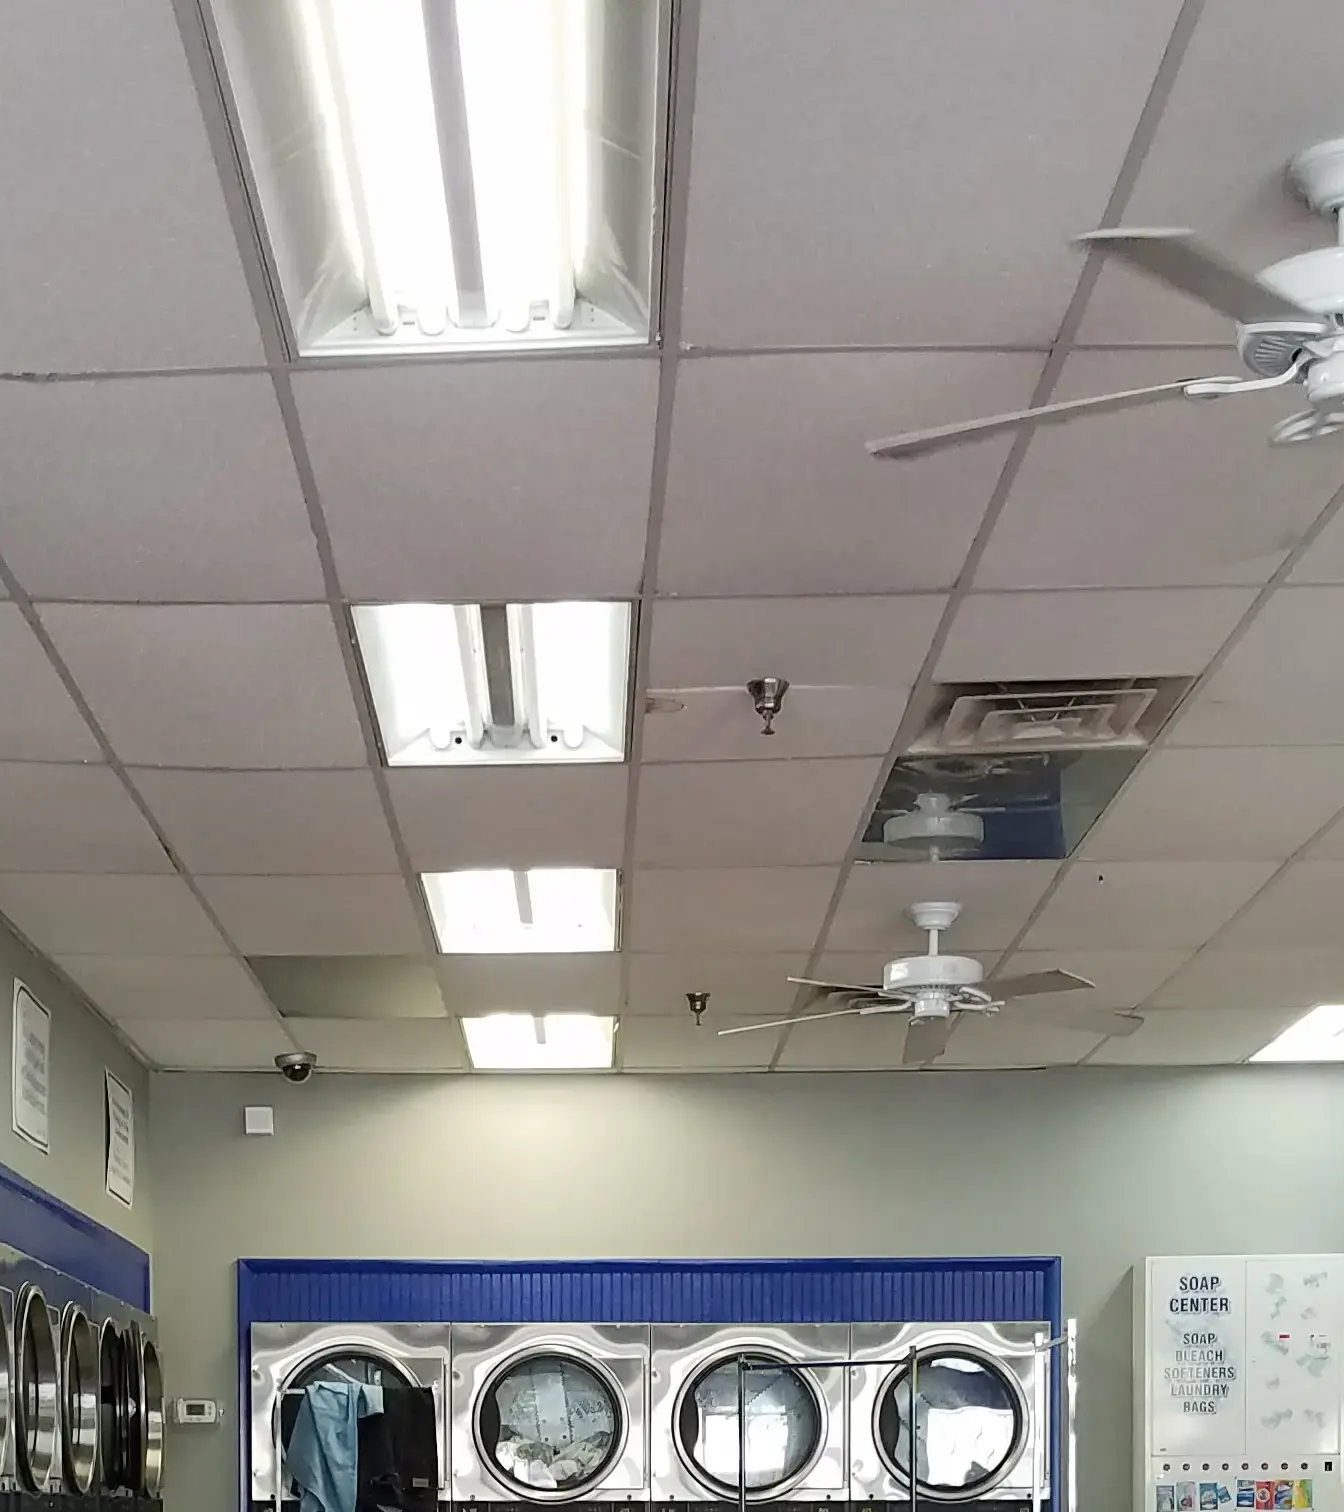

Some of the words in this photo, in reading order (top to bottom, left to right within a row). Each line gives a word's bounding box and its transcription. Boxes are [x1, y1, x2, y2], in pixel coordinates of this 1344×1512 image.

[1179, 1276, 1220, 1291] SOAP
[1169, 1297, 1229, 1312] CENTER
[1183, 1333, 1216, 1345] SOAP
[1175, 1349, 1223, 1362] BLEACH
[1164, 1366, 1235, 1379] SOFTENERS
[1171, 1384, 1227, 1396] LAUNDRY
[1183, 1401, 1216, 1413] BAGS
